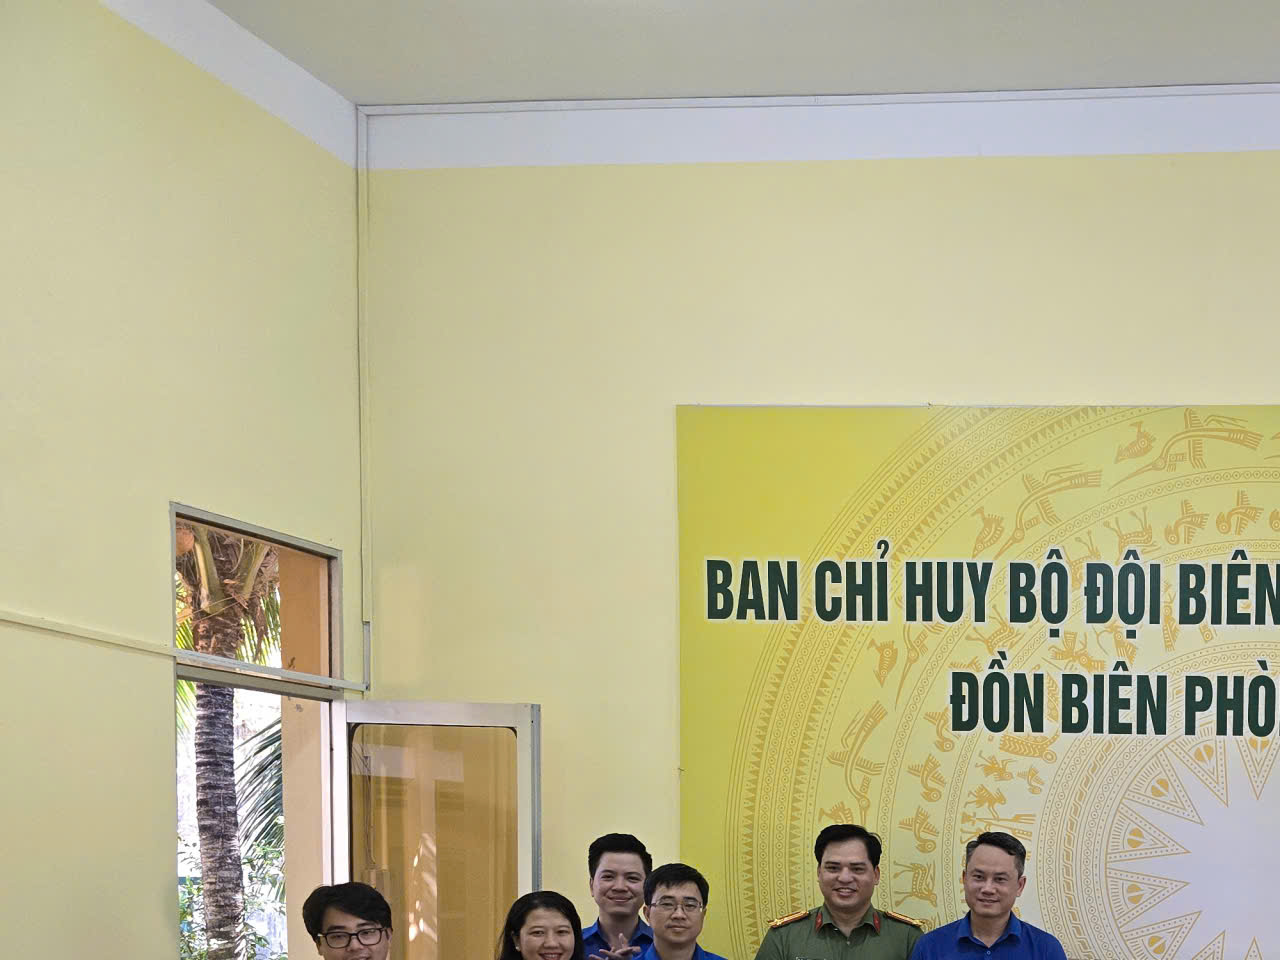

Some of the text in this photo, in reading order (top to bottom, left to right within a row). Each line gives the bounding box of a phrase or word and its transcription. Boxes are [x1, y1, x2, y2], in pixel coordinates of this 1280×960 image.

[706, 560, 798, 620] BAN
[814, 540, 889, 622] CHỈ
[905, 561, 993, 623] HUY
[1009, 549, 1069, 638] BỘ
[1084, 549, 1160, 639] ĐỘI
[949, 651, 1044, 733] ĐỒN
[1061, 661, 1167, 735] BIÊN
